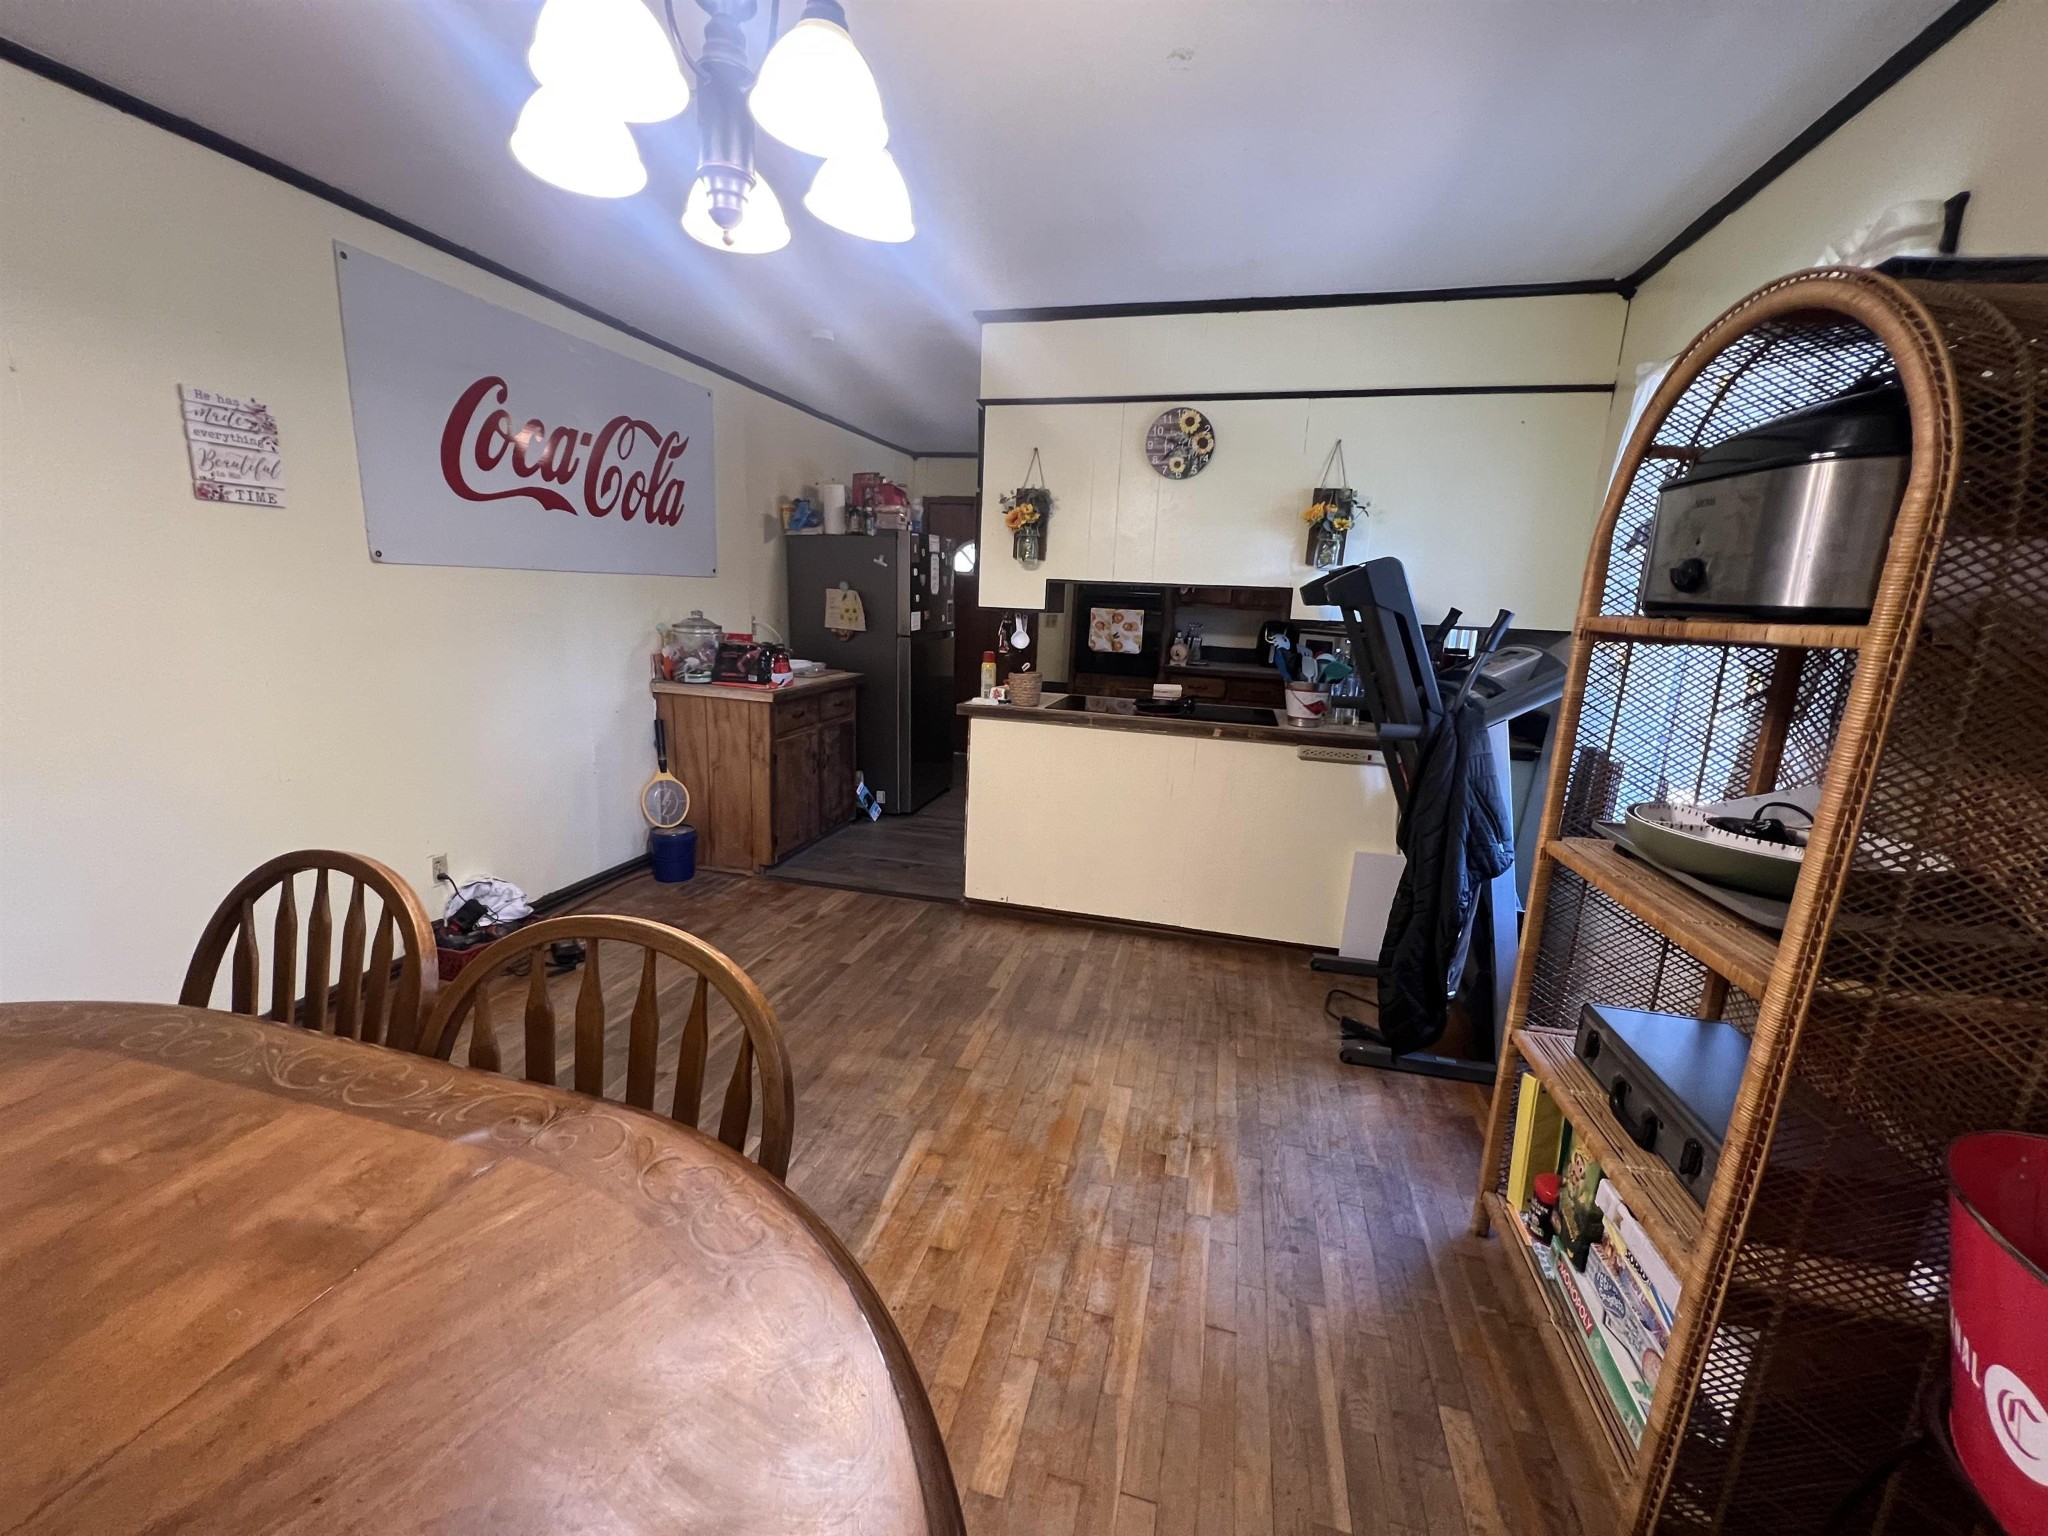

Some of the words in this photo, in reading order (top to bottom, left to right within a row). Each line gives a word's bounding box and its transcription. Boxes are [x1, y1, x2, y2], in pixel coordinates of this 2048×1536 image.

[194, 389, 210, 400] He
[216, 393, 240, 407] has
[1163, 415, 1173, 424] 11
[1152, 426, 1164, 436] 10
[1204, 424, 1211, 433] 2
[193, 428, 264, 448] everything
[1148, 441, 1154, 450] 9
[441, 375, 690, 527] Coca-Cola
[199, 446, 282, 481] Beautiful
[1152, 456, 1158, 464] 8
[1162, 465, 1168, 475] 7
[1191, 465, 1198, 475] 5
[235, 489, 278, 504] TIME
[1558, 1260, 1593, 1330] MONOPOLY
